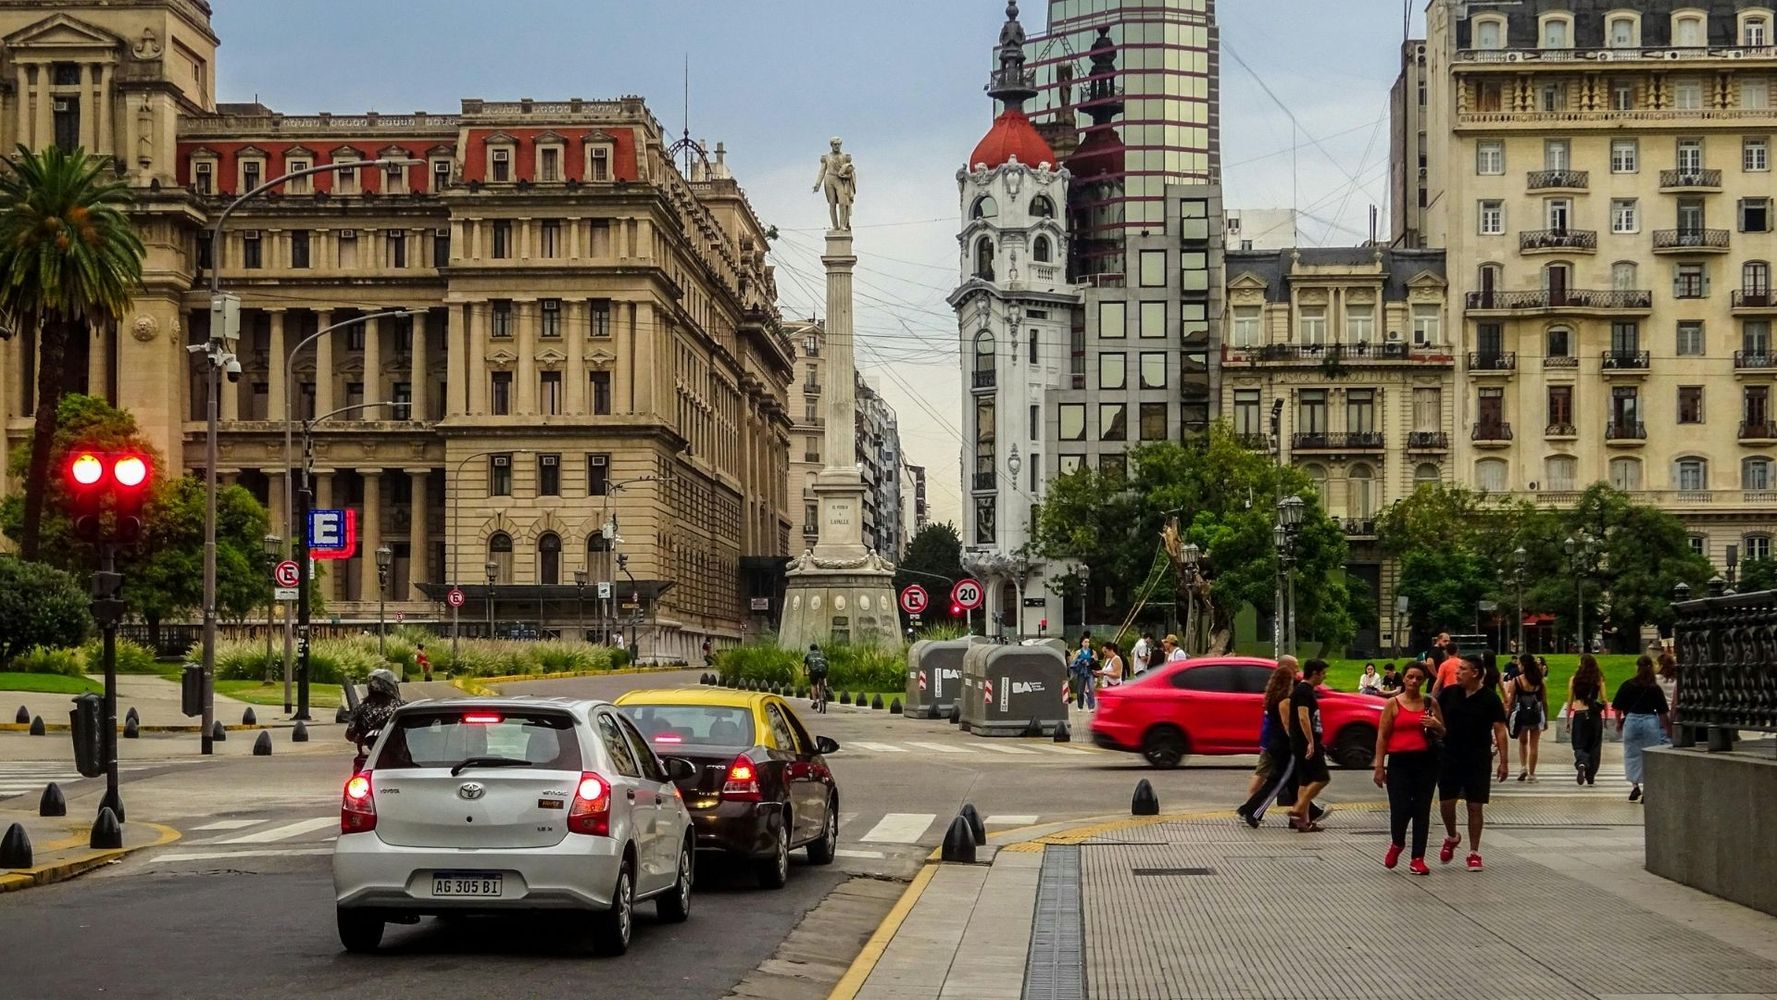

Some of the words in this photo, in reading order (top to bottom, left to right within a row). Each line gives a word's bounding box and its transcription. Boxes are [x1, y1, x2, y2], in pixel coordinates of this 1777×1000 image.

[313, 513, 339, 544] E
[908, 591, 920, 607] E
[959, 588, 977, 601] 20
[1012, 681, 1033, 694] BA
[435, 880, 452, 893] AG
[455, 880, 479, 893] 305
[482, 881, 498, 893] BI
